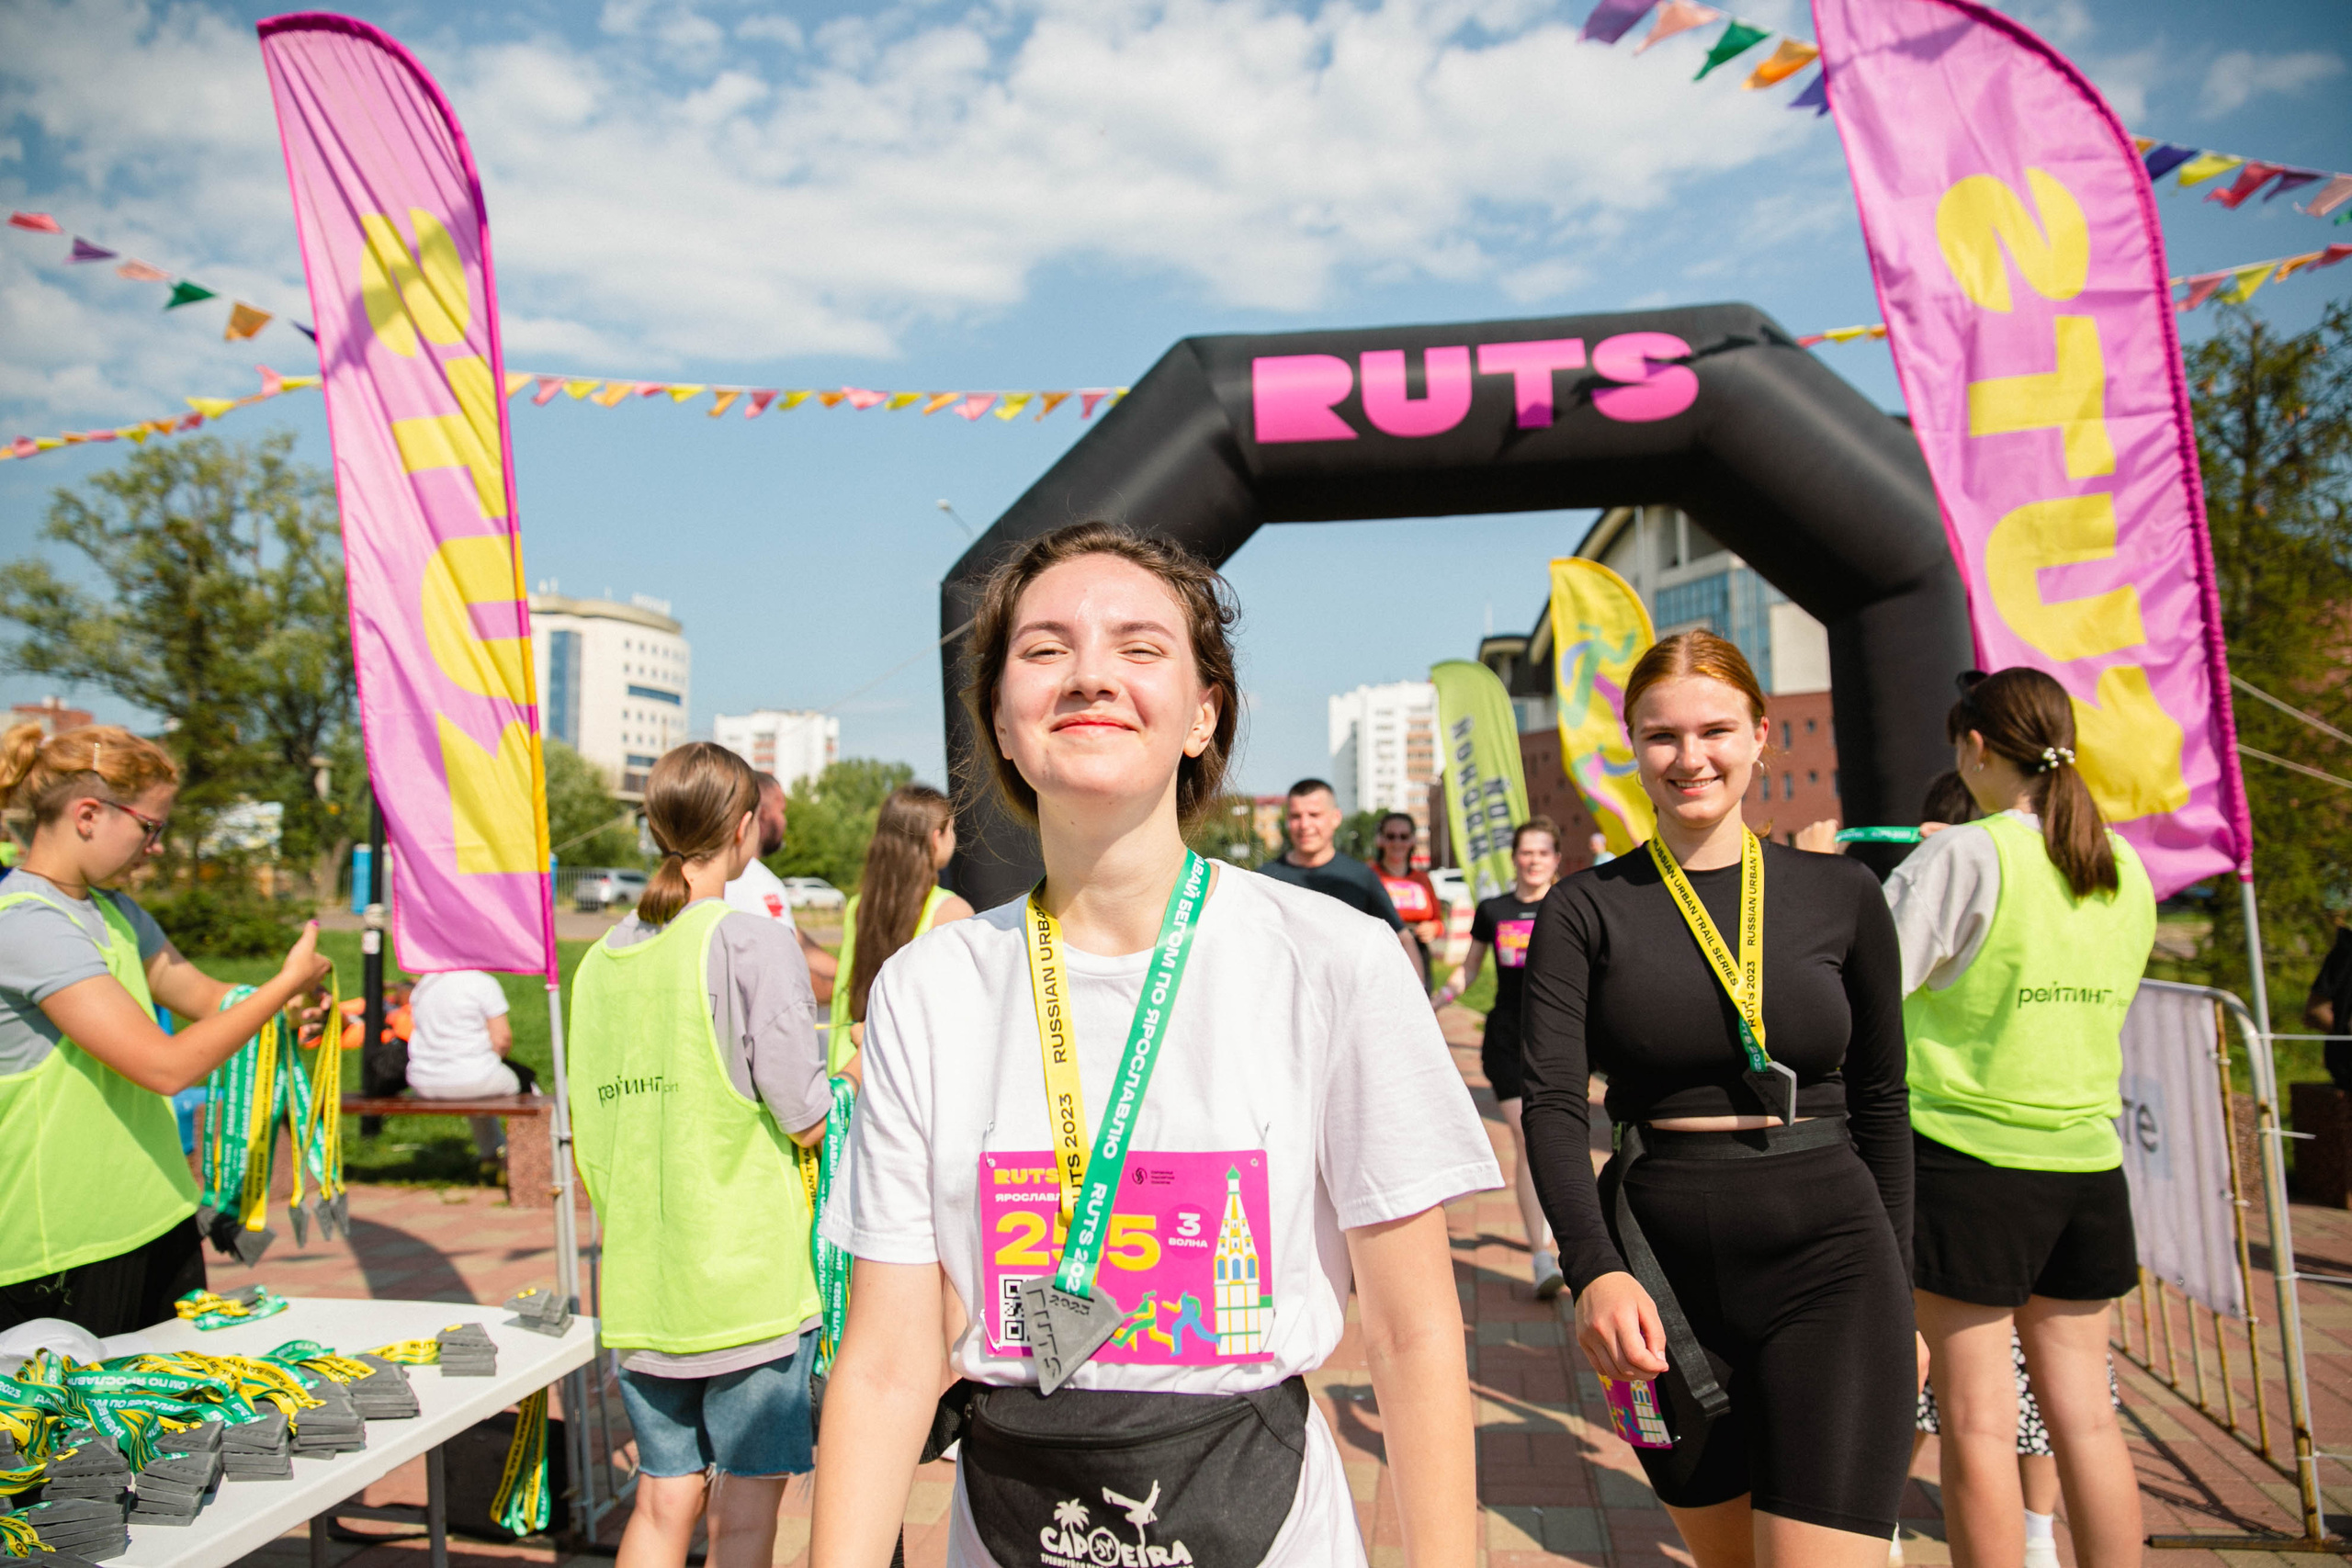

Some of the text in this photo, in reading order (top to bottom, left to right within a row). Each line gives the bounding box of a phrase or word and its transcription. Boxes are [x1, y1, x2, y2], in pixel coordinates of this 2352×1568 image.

[1252, 331, 1700, 444] RUTS
[1748, 857, 1758, 896] URBAN
[1036, 905, 1054, 962] URBA
[1652, 836, 1739, 987] RUSSIAN URBAN TRAIL SERIES
[1747, 897, 1757, 946] RUSSIAN
[1747, 960, 1756, 990] 2023
[1043, 967, 1067, 1064] RUSSIAN
[1065, 851, 1205, 1295] АВАЙ БЕГОМ ПО ЯРОСЛАВЛЮ RUTS 202
[1748, 1045, 1762, 1071] 202
[1059, 1093, 1078, 1148] 2023
[993, 1168, 1060, 1185] RUTS
[995, 1192, 1061, 1202] ЯРОСЛАВЛ
[995, 1211, 1161, 1271] 25
[1168, 1237, 1208, 1248] ВОЛНА
[1176, 1212, 1201, 1237] 3
